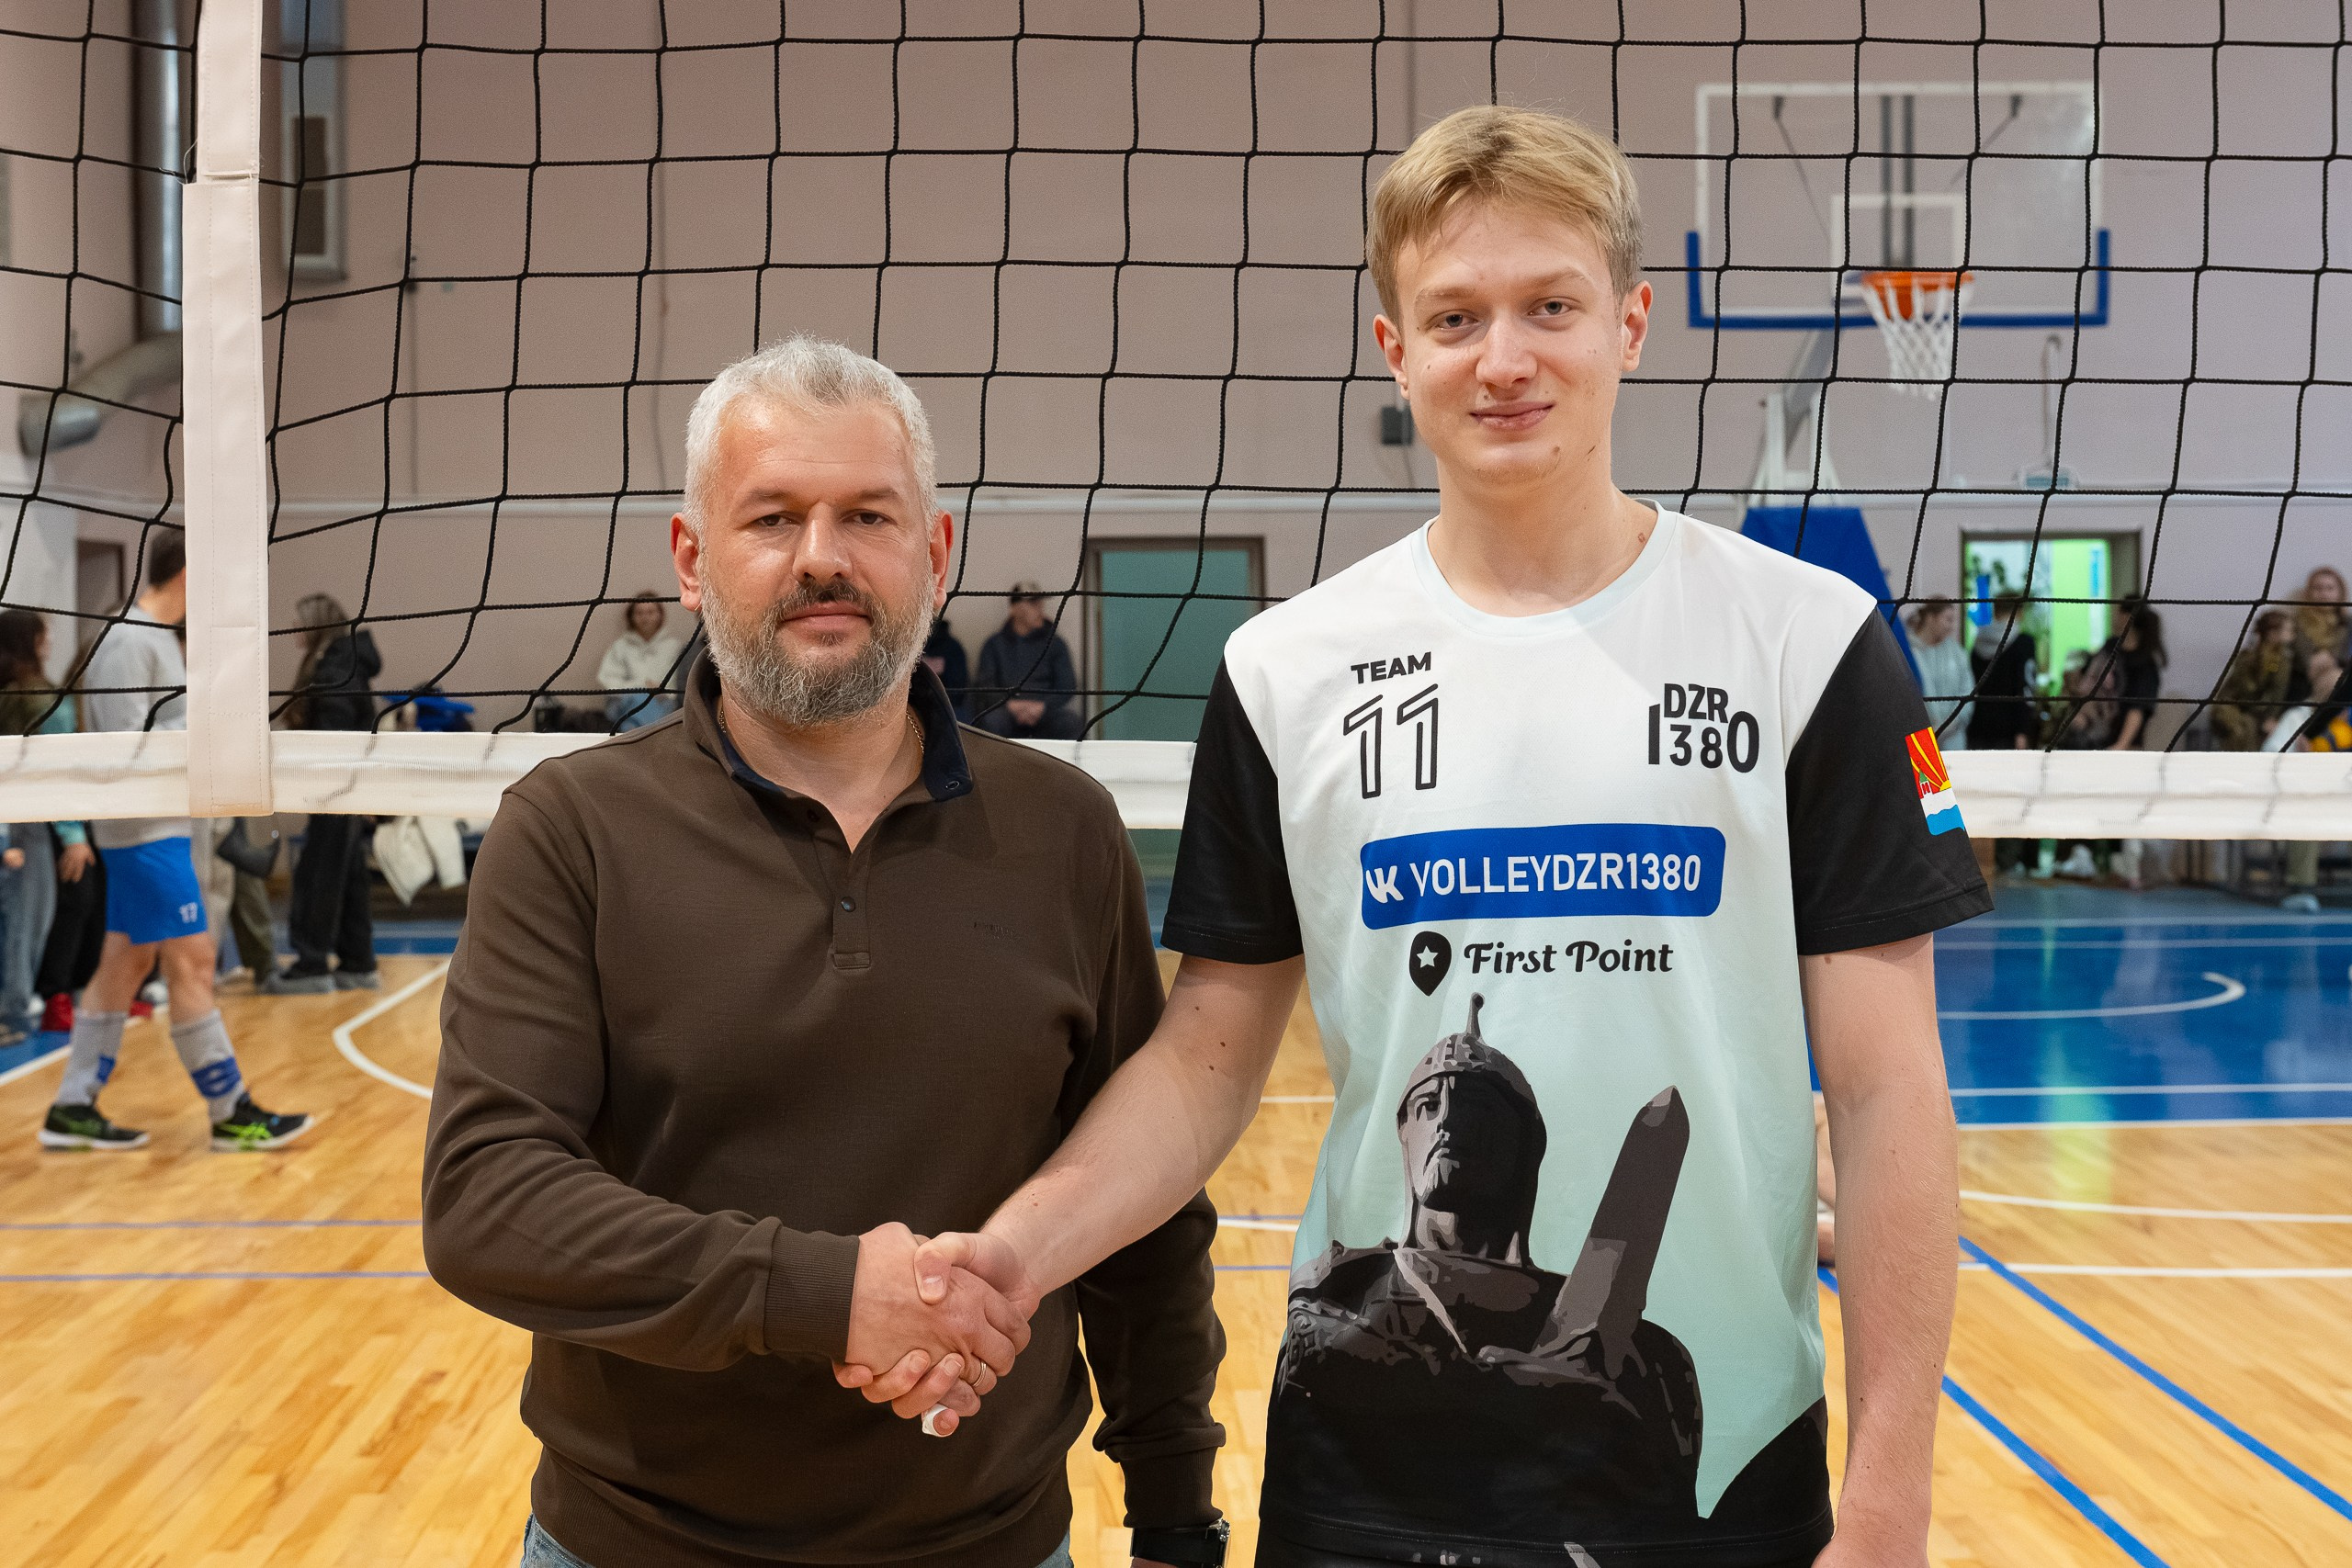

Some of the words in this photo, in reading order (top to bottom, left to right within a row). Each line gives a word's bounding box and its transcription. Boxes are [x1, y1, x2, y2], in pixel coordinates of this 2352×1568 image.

[1351, 651, 1431, 684] TEAM
[1663, 682, 1729, 724] DZR
[1343, 683, 1439, 799] 11
[1648, 704, 1759, 773] 1380
[1409, 852, 1701, 897] VOLLEYDZR1380
[1464, 942, 1557, 974] First
[1566, 939, 1674, 973] Point
